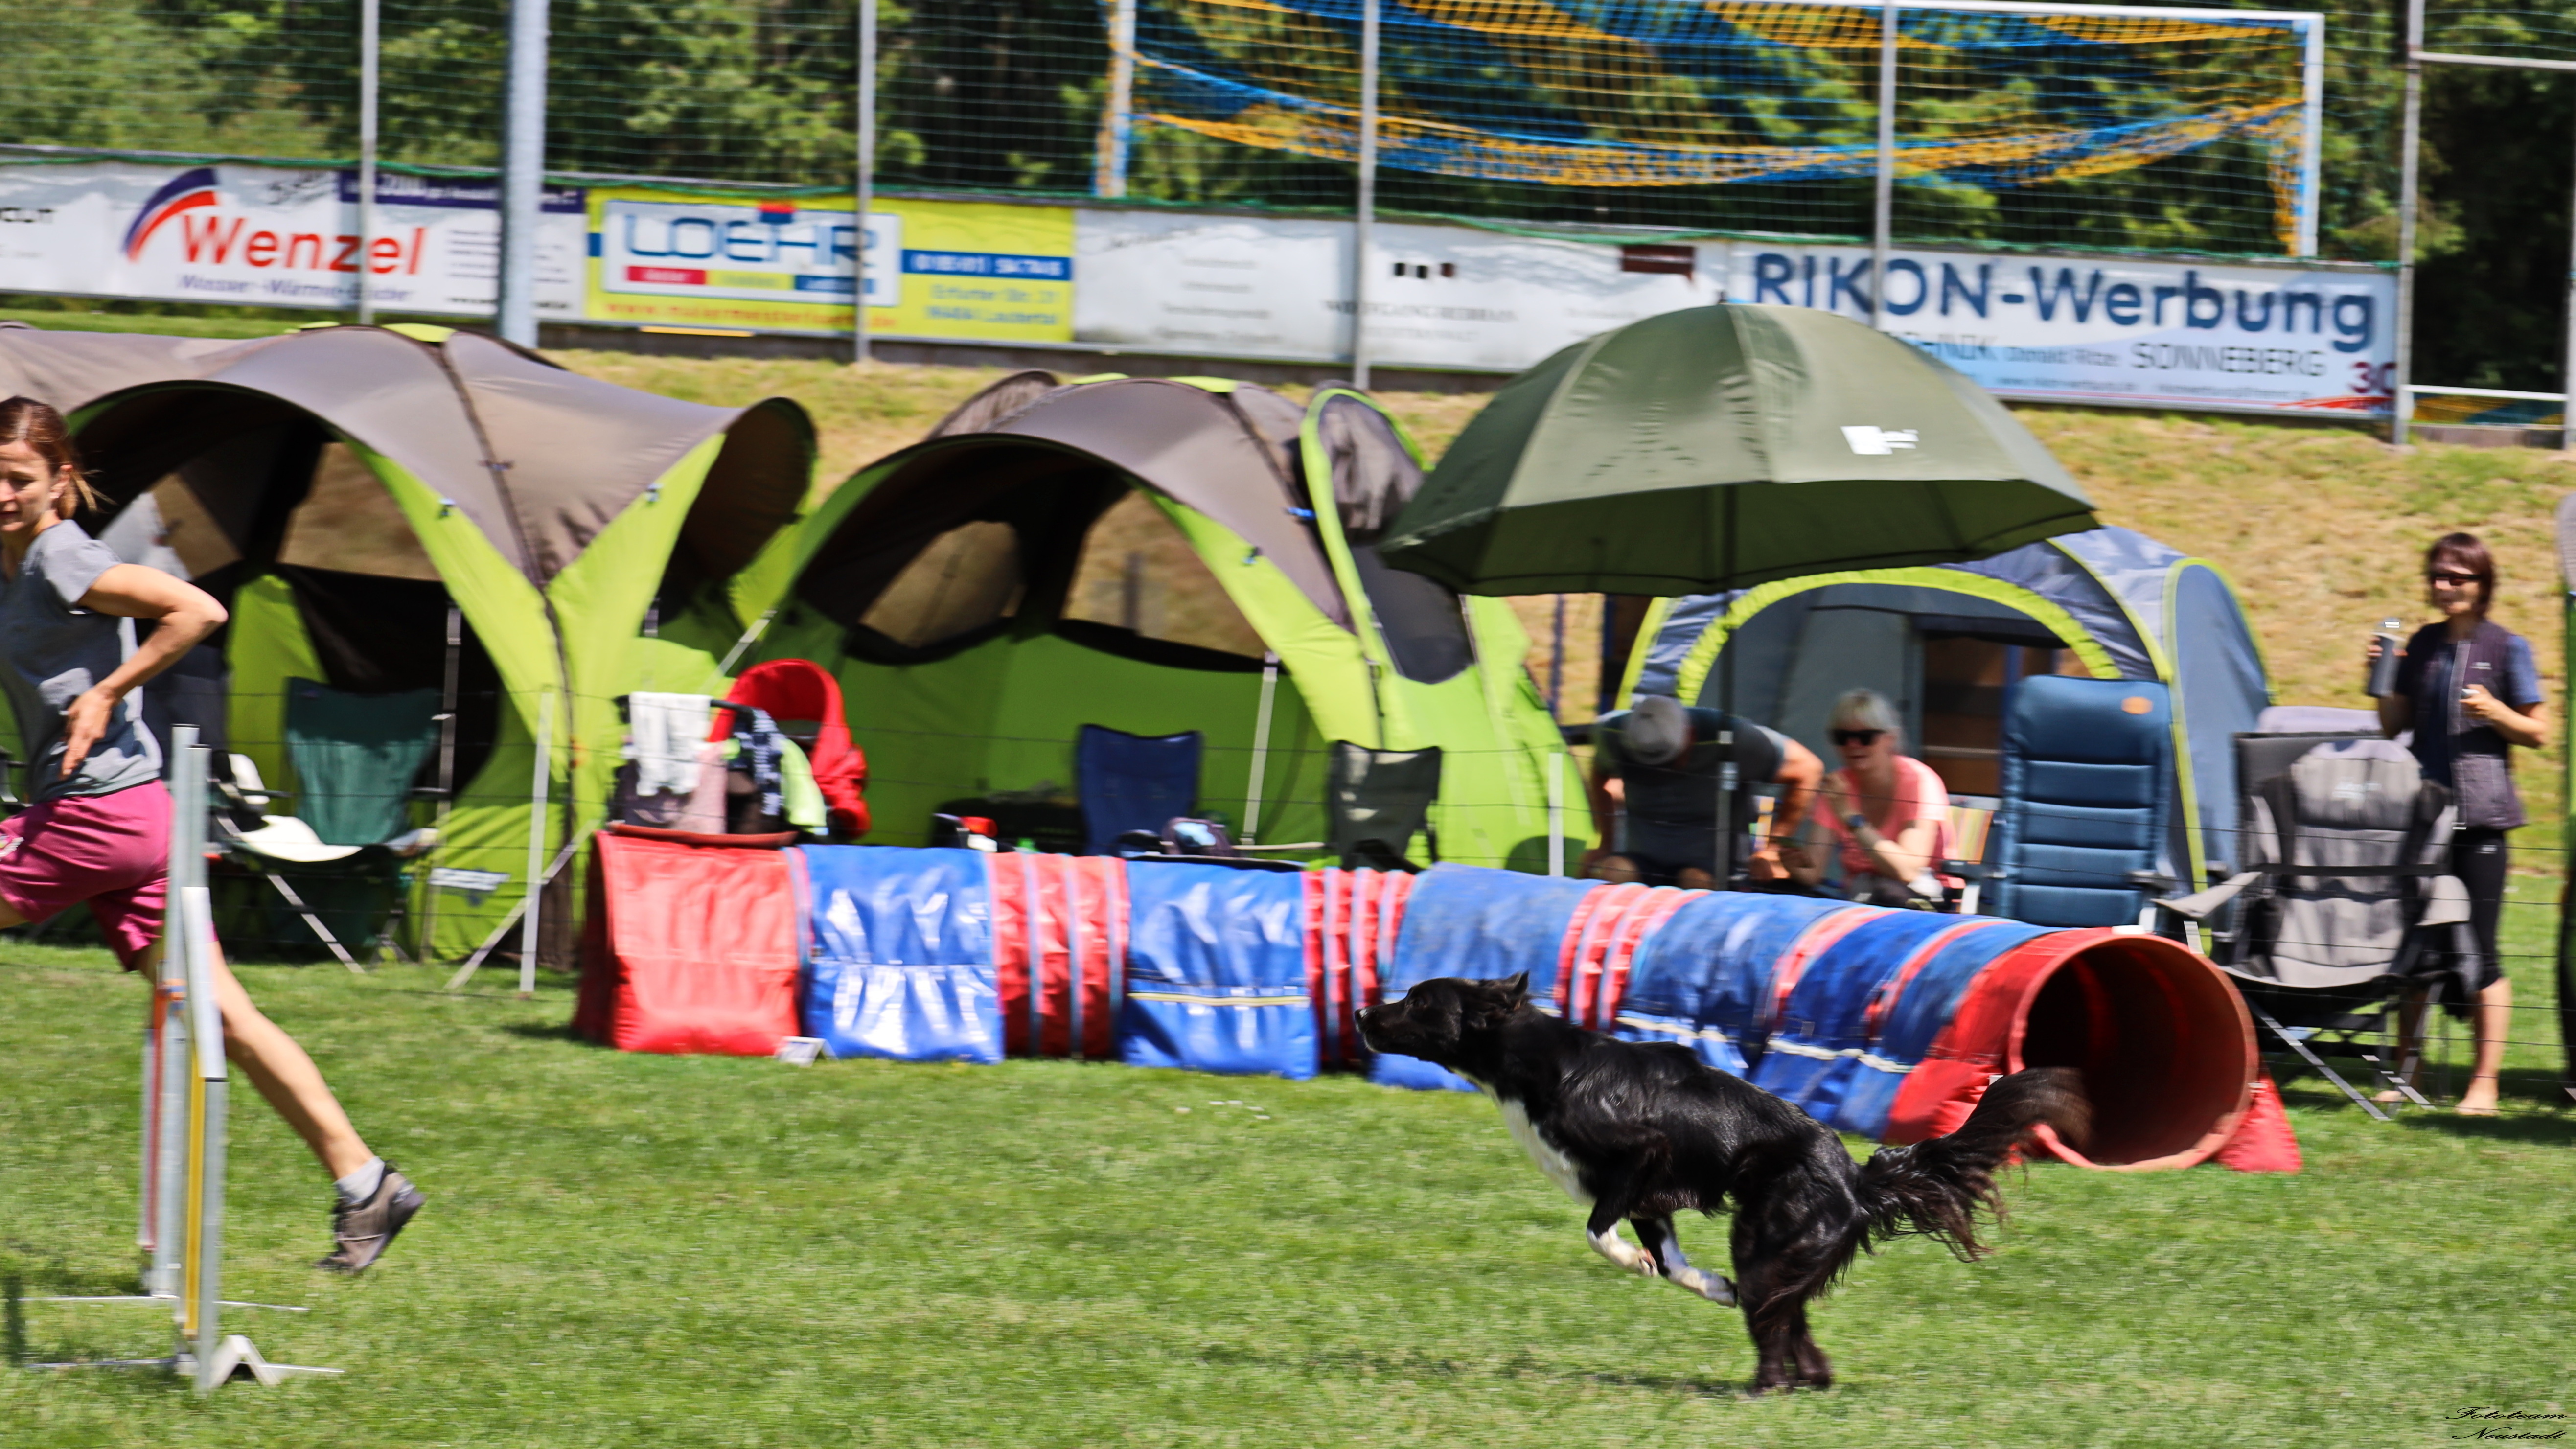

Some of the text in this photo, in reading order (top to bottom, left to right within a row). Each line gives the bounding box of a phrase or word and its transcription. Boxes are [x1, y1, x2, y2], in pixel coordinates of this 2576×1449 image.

[181, 213, 427, 275] Wenzel
[1754, 252, 2378, 353] RIKON-Werbung
[2131, 342, 2327, 377] SONNEBERG
